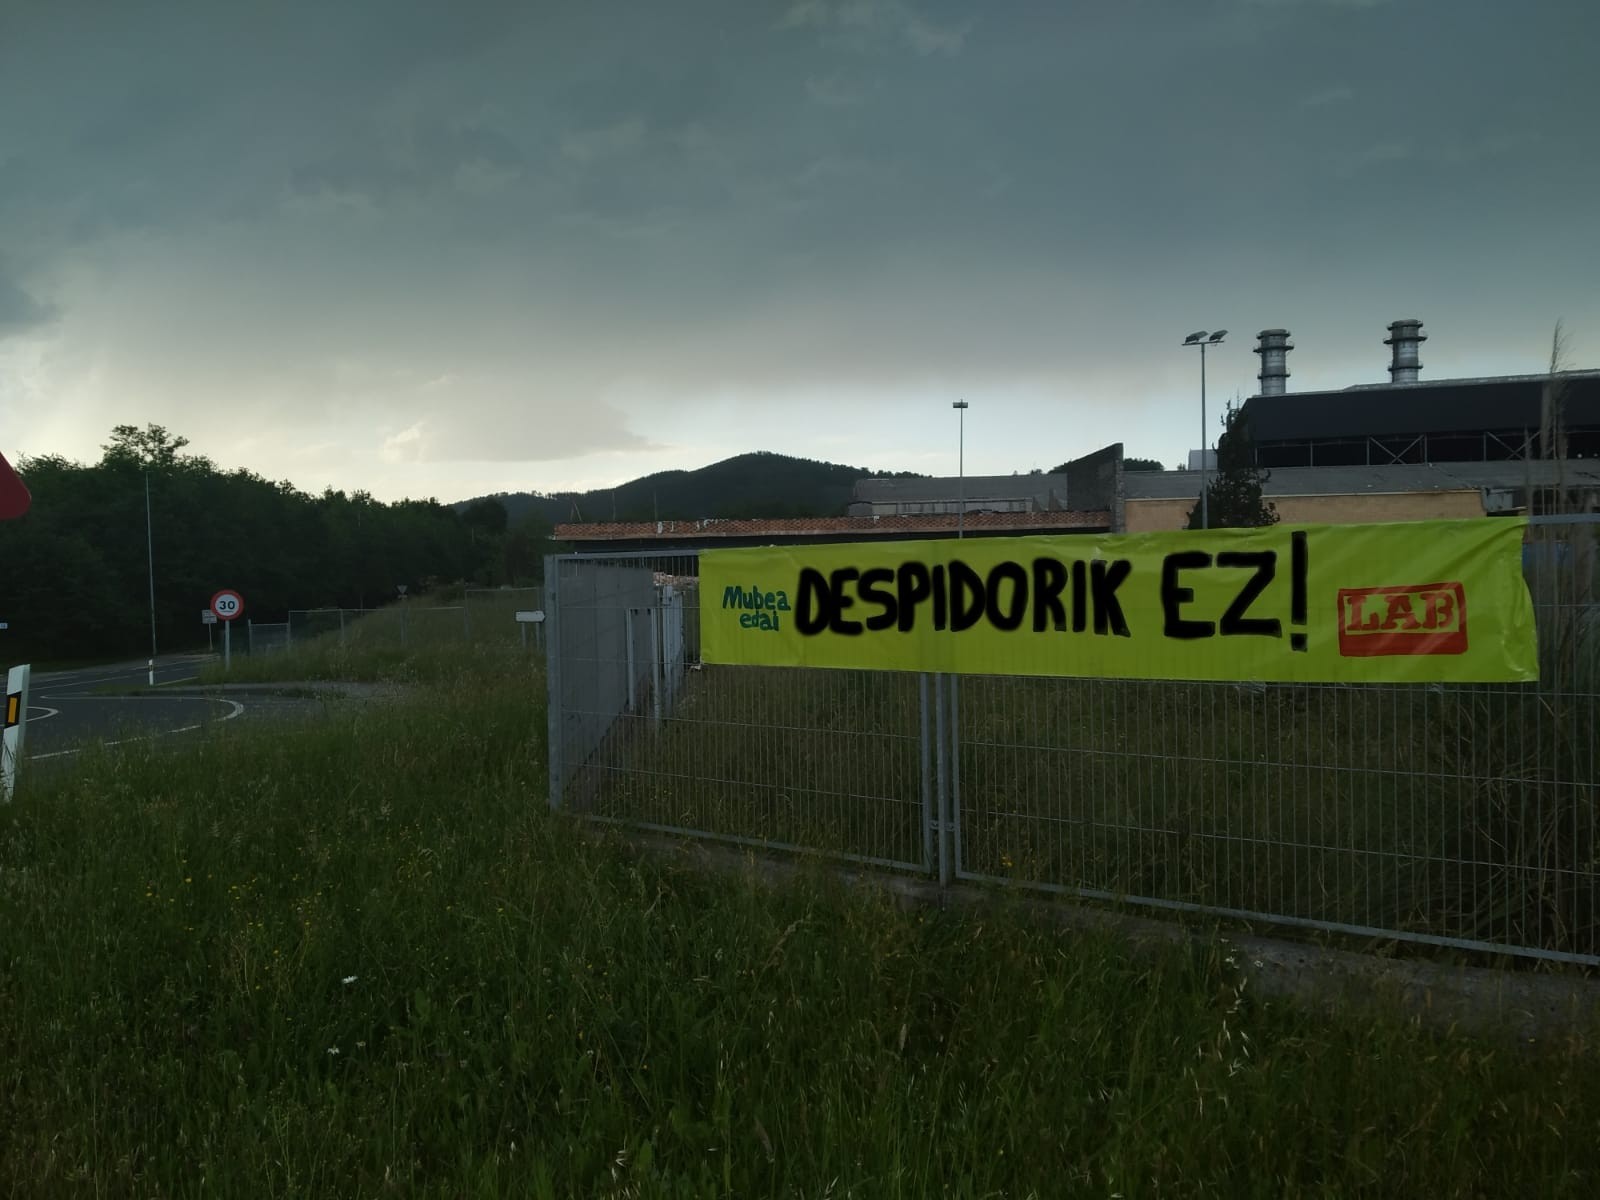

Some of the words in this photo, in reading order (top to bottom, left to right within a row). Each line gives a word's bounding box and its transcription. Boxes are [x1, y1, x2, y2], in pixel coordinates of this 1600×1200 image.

[219, 600, 236, 610] 30
[722, 585, 791, 610] Mubea
[796, 557, 1132, 637] DESPIDORIK
[1162, 530, 1308, 652] EZ!
[1345, 592, 1455, 631] LAB
